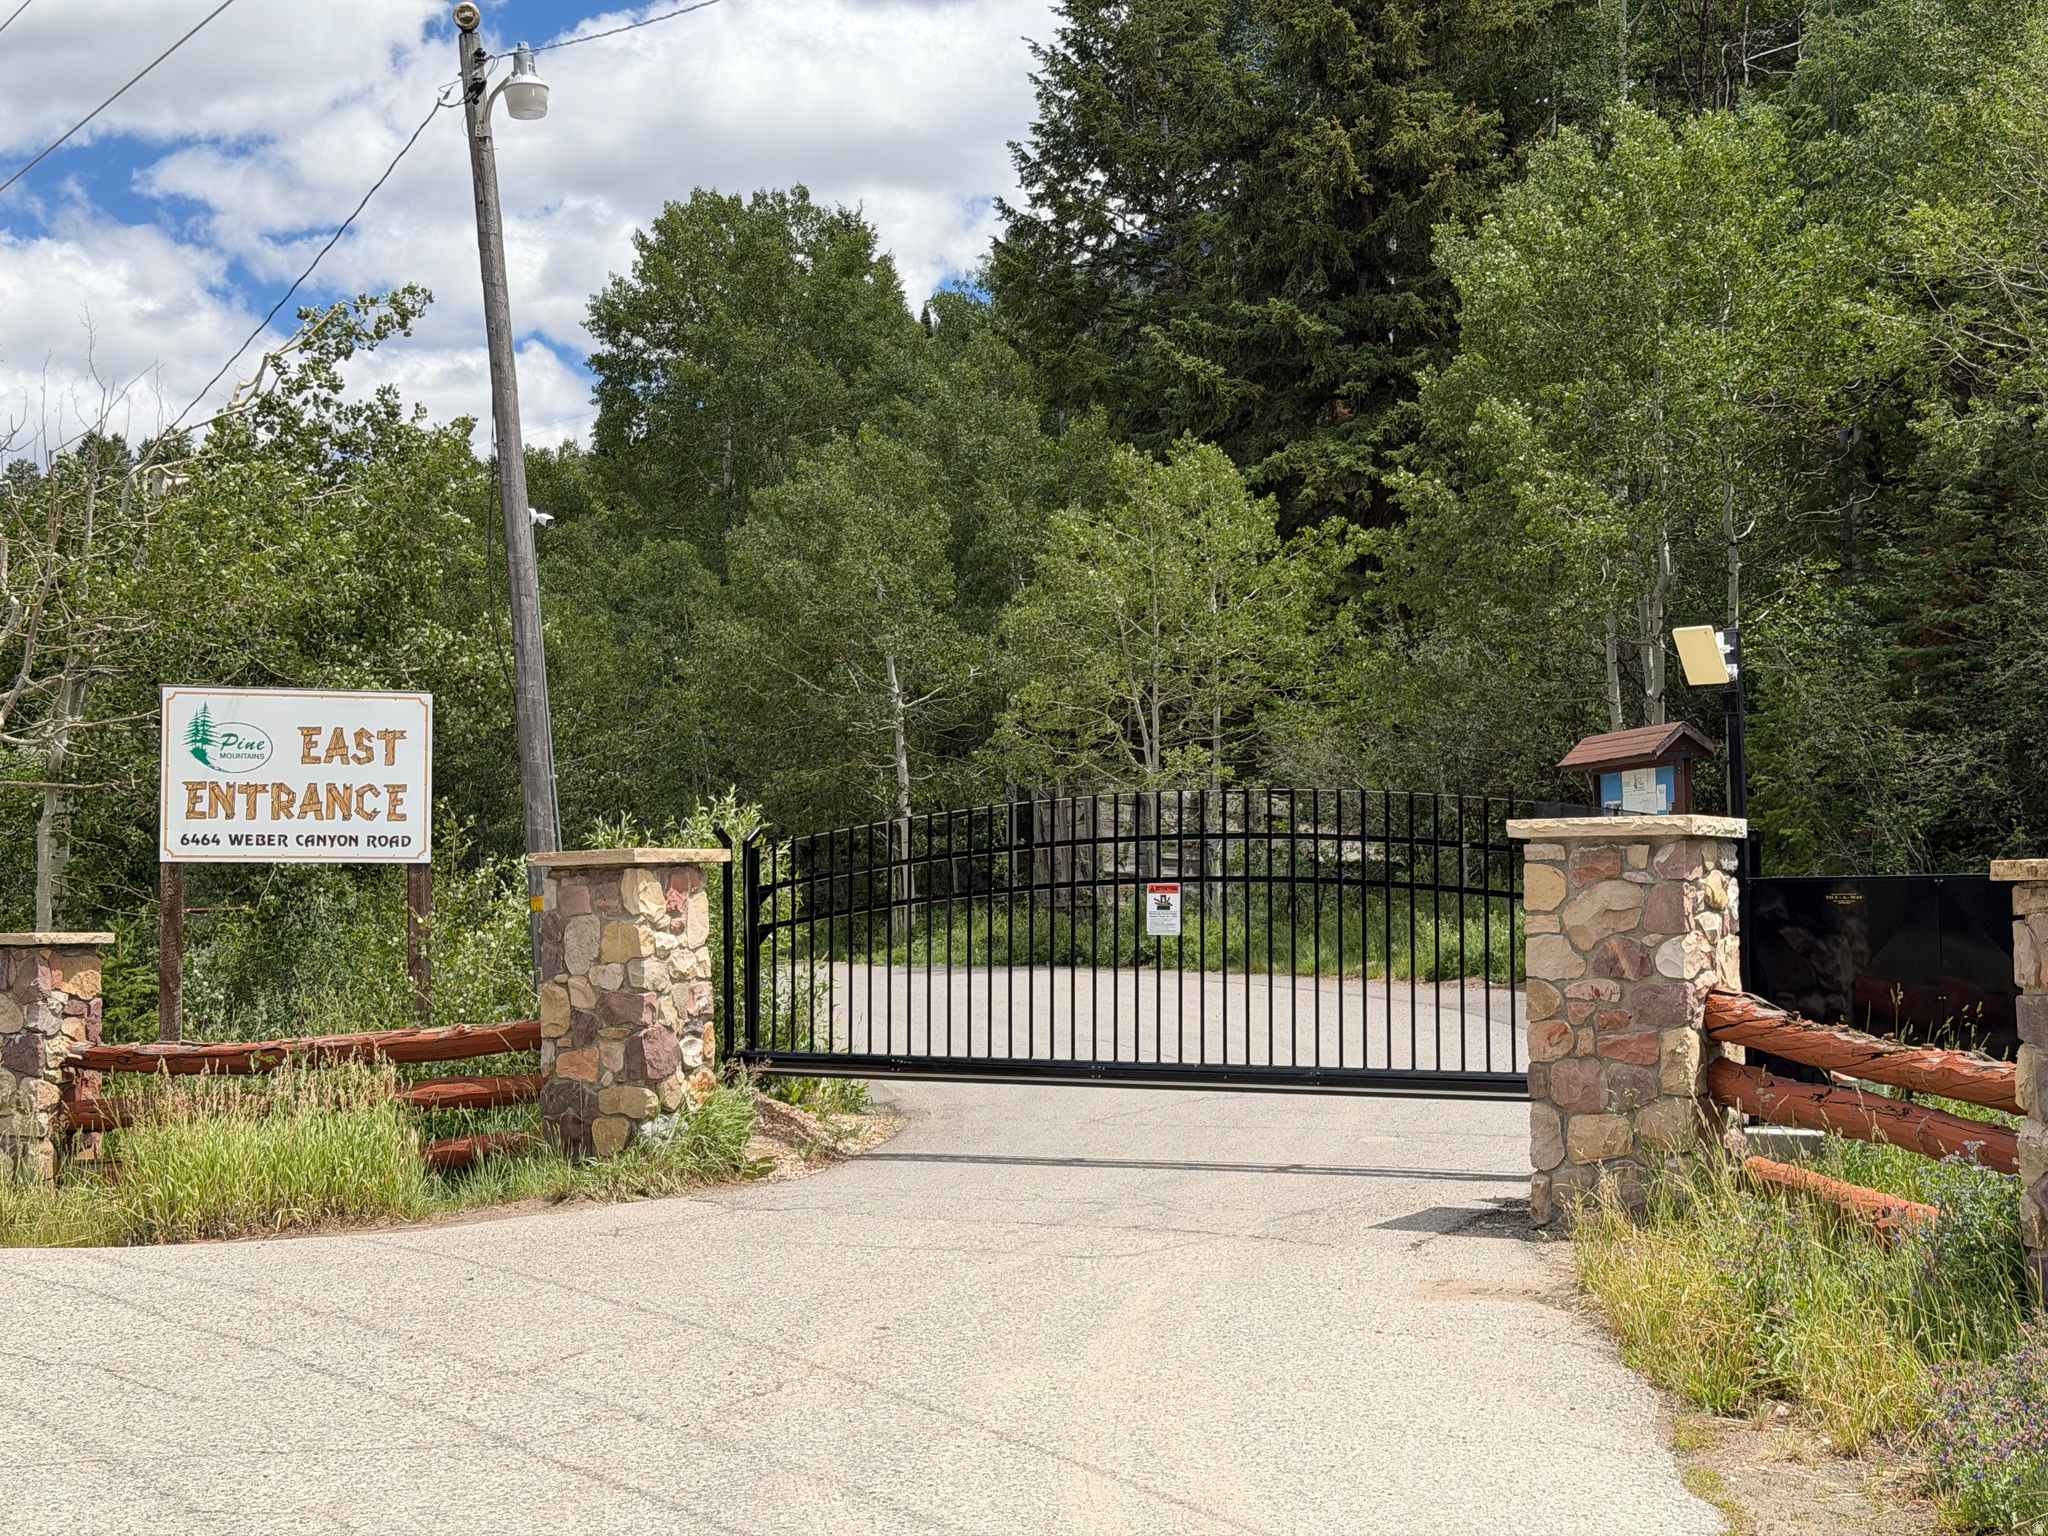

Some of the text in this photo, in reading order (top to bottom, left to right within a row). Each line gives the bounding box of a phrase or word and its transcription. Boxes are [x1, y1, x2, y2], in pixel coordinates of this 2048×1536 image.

[220, 733, 265, 751] Pine
[297, 726, 407, 766] EAST
[219, 752, 265, 760] MOUNTAINS
[182, 780, 407, 822] ENTRANCE
[180, 833, 412, 848] 6464 WEBER CANYON ROAD
